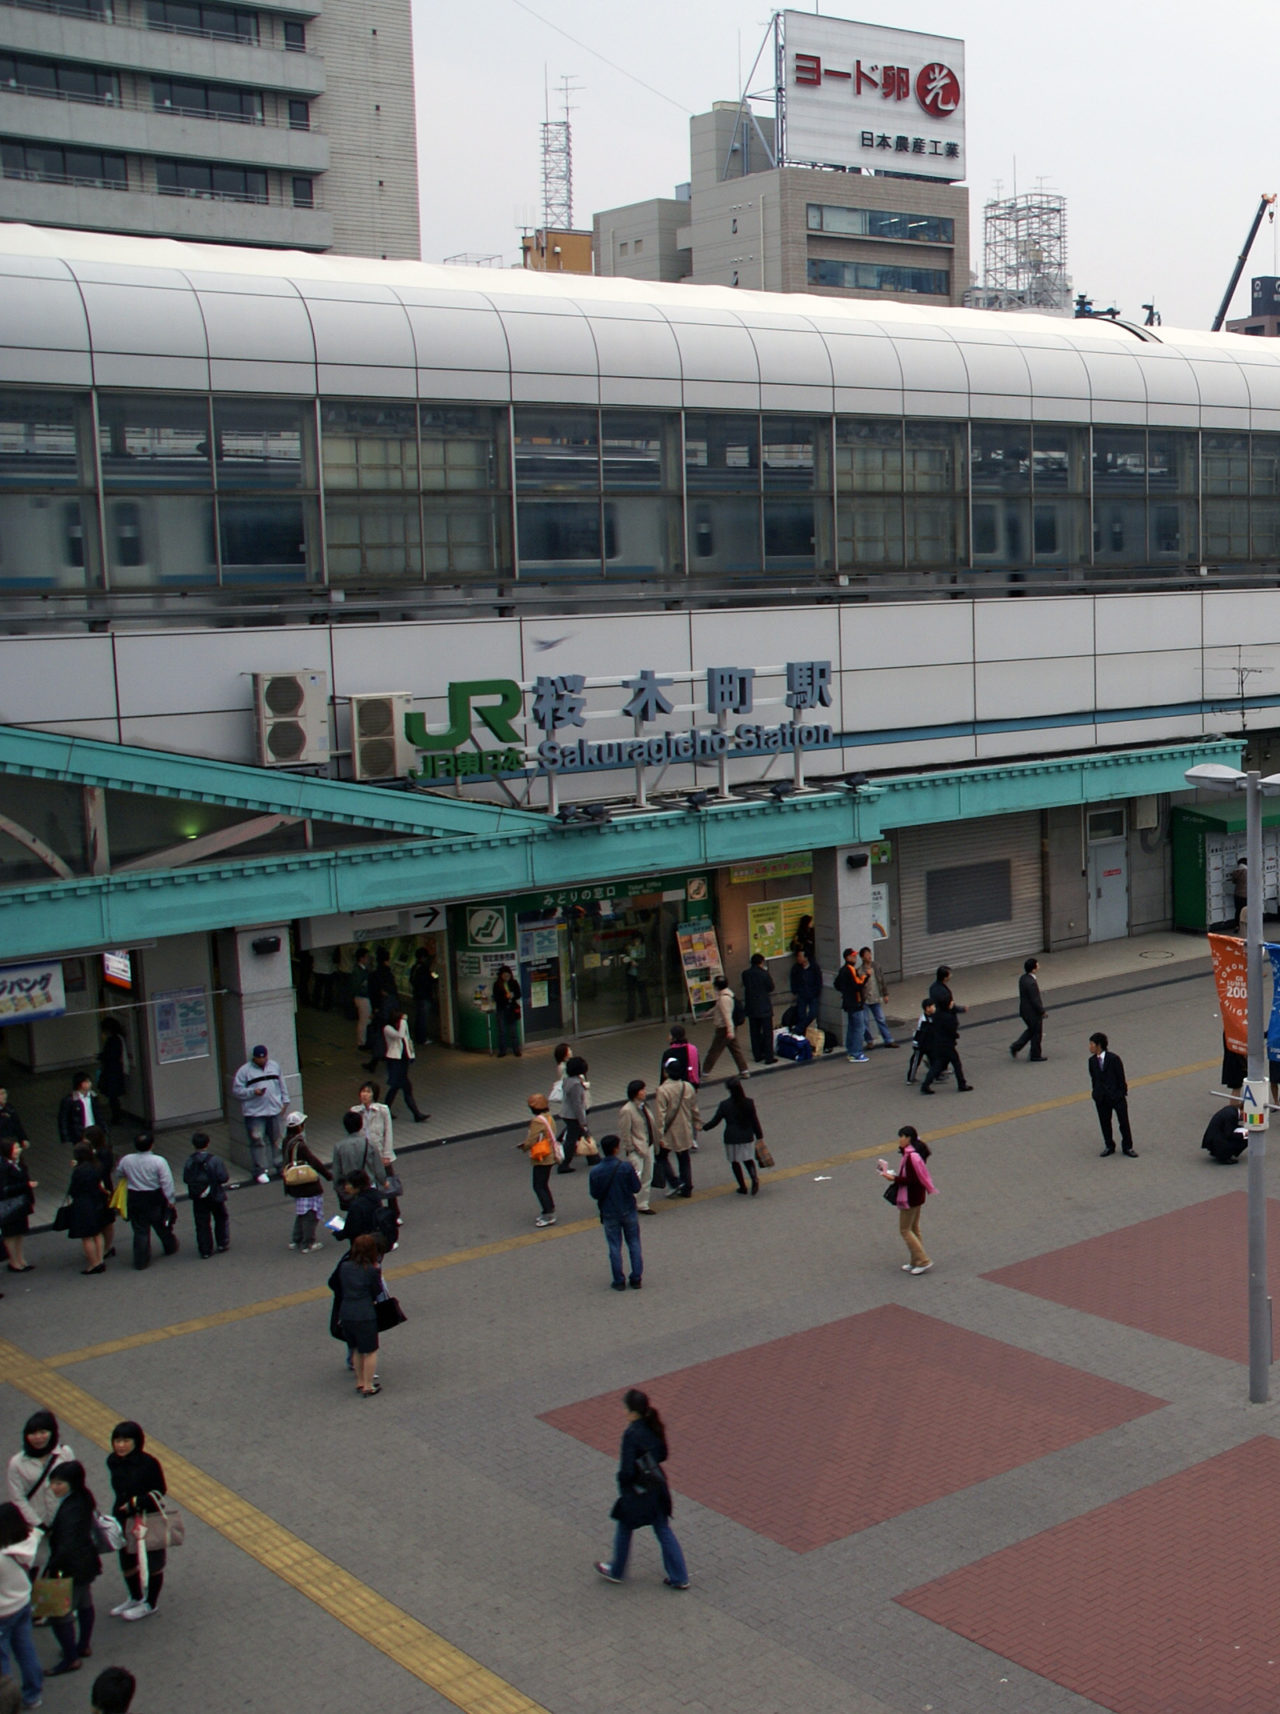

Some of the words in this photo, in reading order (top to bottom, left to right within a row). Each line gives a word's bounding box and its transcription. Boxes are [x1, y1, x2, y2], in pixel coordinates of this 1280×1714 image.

[795, 53, 910, 99] ヨード卵
[924, 64, 956, 111] 光
[861, 131, 960, 158] 日本農産工業
[532, 660, 832, 731] 桜木町駅
[405, 679, 525, 749] JR
[537, 728, 729, 771] Sakuragicho
[734, 721, 834, 752] Station
[409, 747, 526, 779] JR東日本
[543, 886, 616, 906] みどりの窓口
[1219, 963, 1248, 985] YOKOH
[1226, 986, 1248, 998] 200
[1243, 1085, 1257, 1107] A
